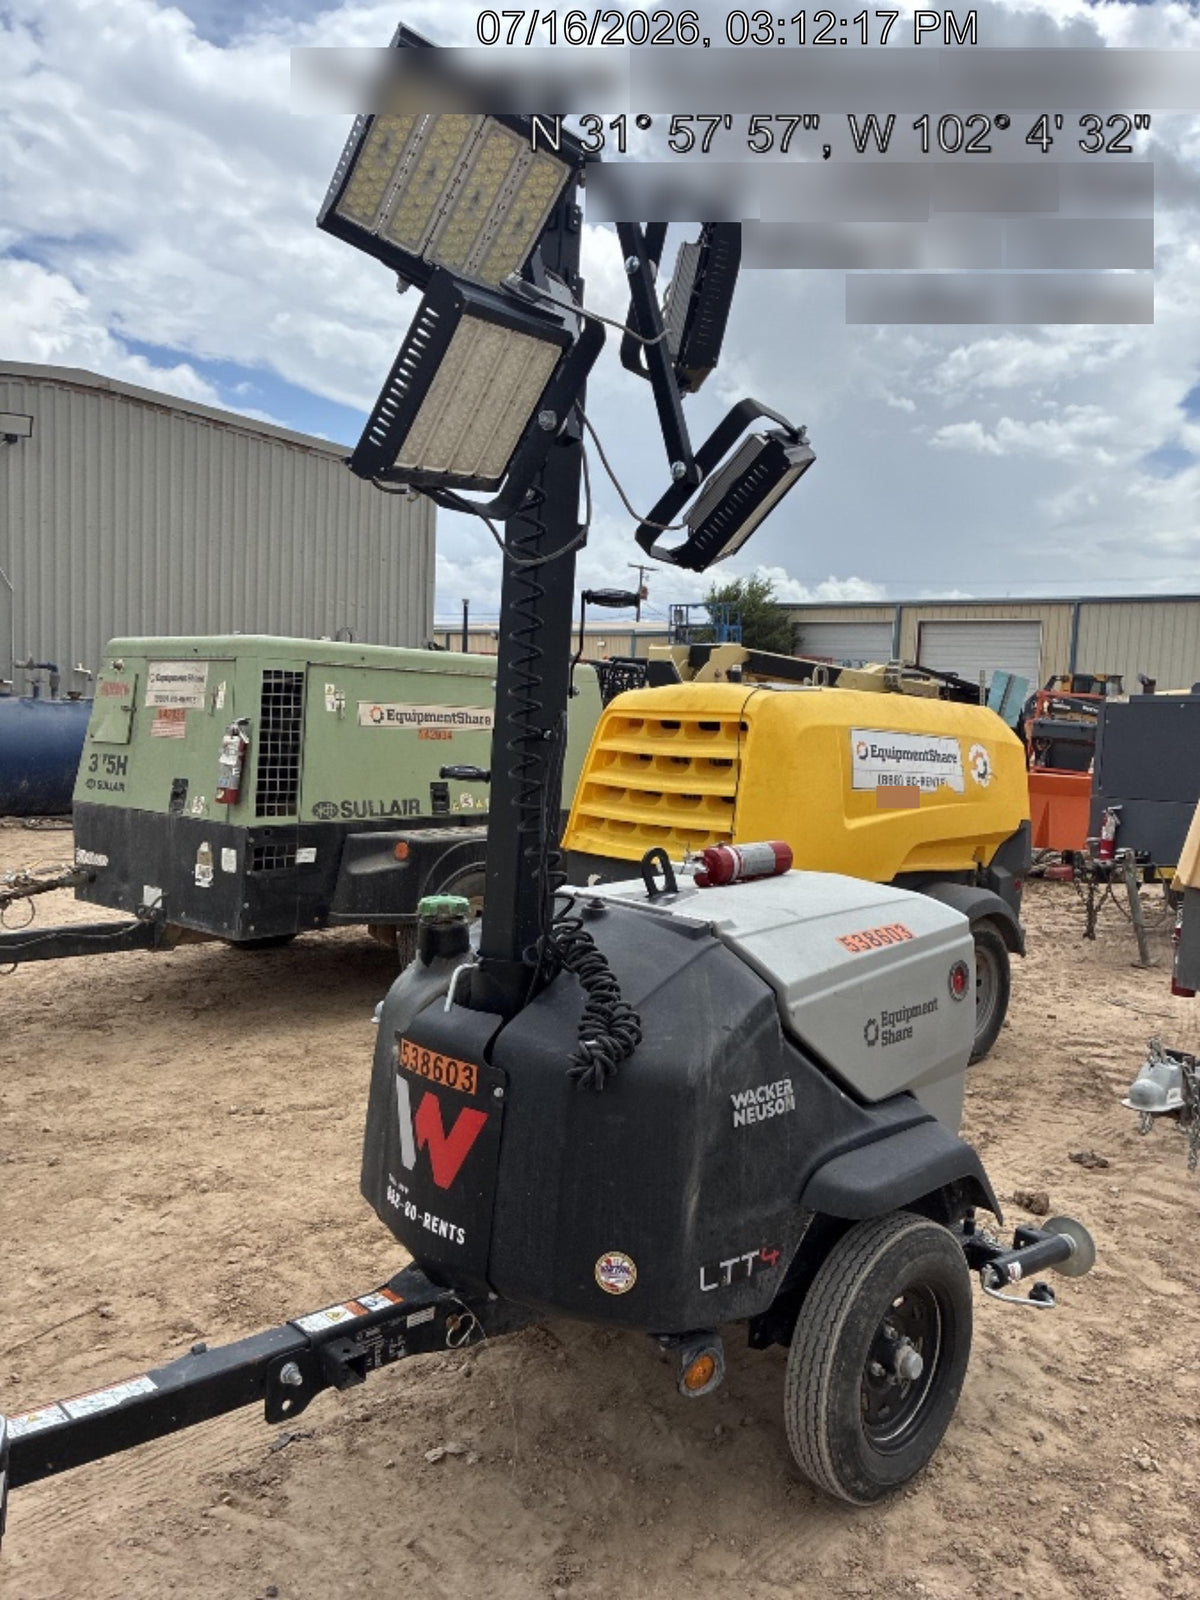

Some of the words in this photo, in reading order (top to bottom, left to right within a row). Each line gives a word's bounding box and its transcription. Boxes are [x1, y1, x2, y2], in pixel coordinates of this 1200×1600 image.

[386, 708, 491, 726] EquipmentShare
[870, 744, 957, 763] EquipmentShare
[340, 799, 421, 818] SULLAIR
[838, 923, 914, 953] 538603
[881, 997, 939, 1027] Equipment
[881, 1026, 913, 1046] Share
[401, 1041, 475, 1092] 538603
[730, 1079, 794, 1110] WACKER
[733, 1095, 796, 1128] NEUSON
[700, 1247, 780, 1292] LTT4
